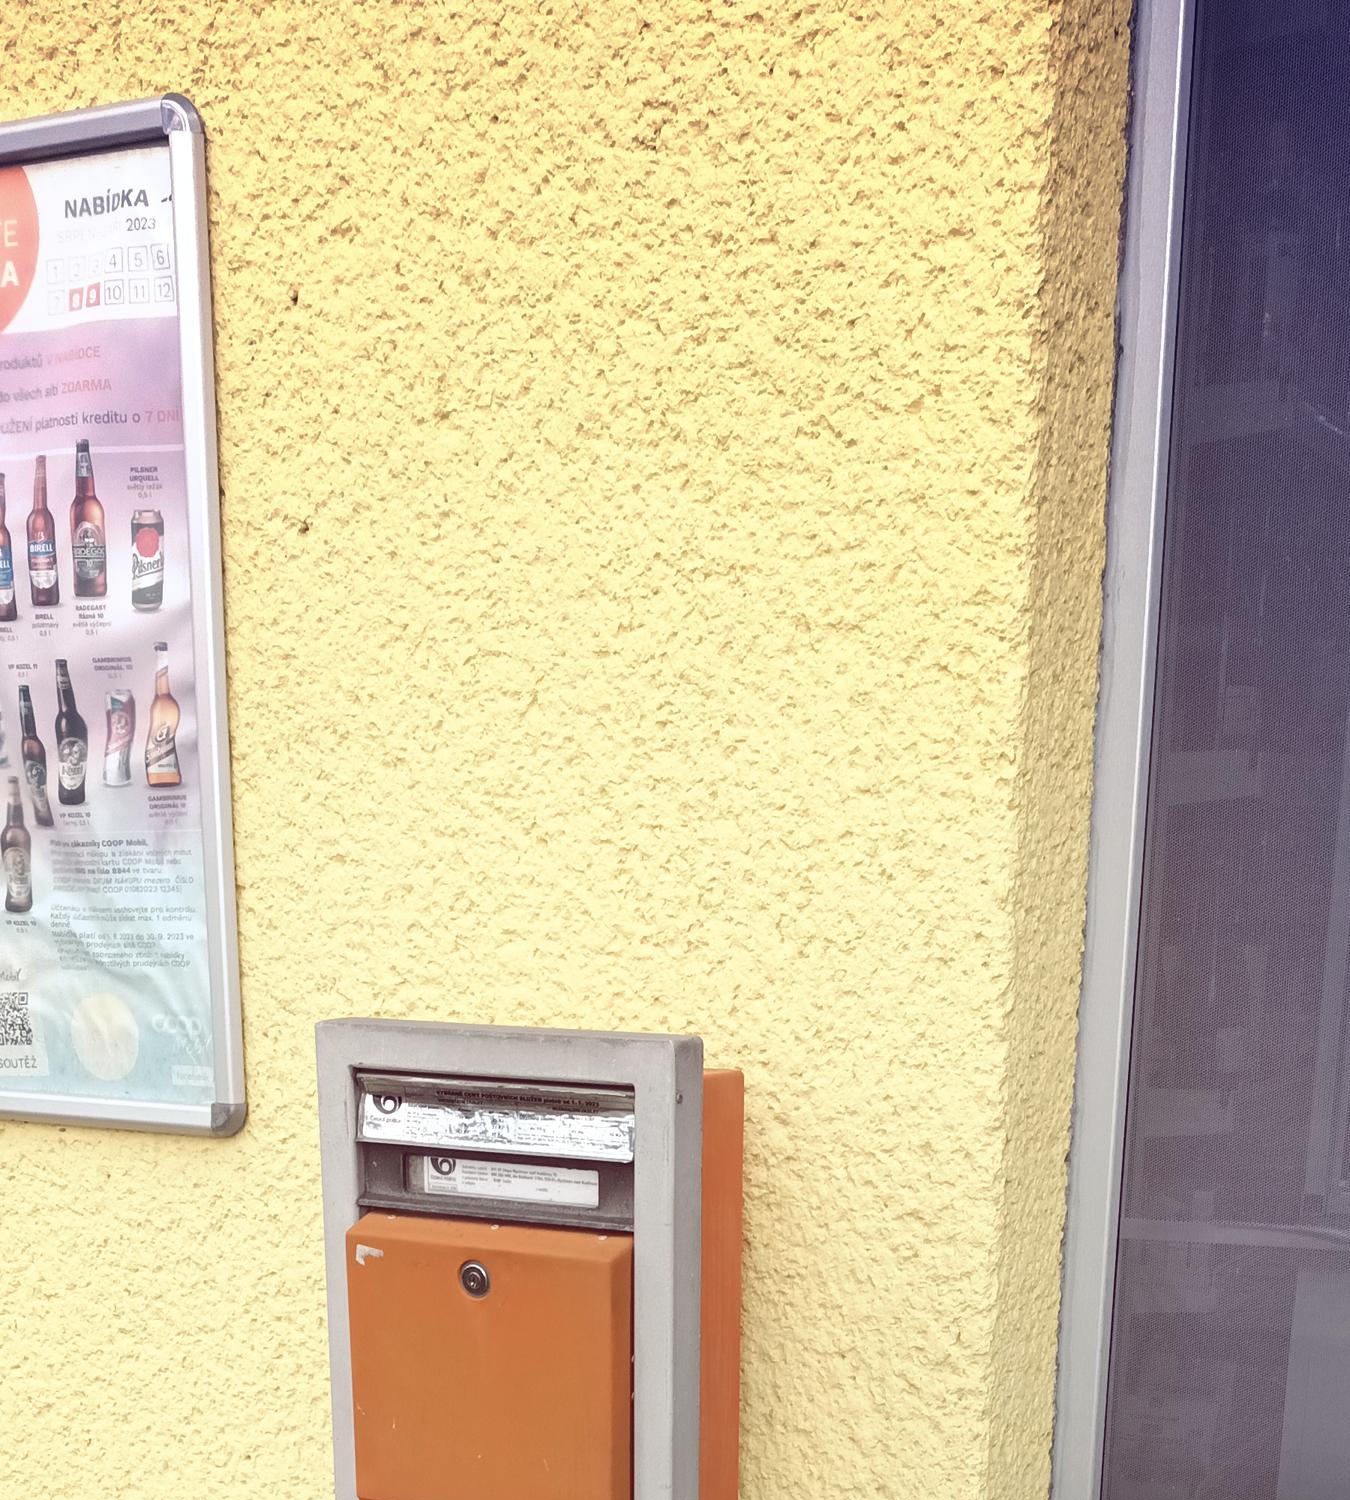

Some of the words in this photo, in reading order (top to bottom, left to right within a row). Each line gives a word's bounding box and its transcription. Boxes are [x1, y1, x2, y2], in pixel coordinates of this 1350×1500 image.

[126, 217, 156, 231] 2023
[108, 254, 117, 269] 4
[134, 252, 143, 267] 5
[156, 250, 165, 265] 6
[89, 287, 98, 303] 9
[106, 285, 122, 300] 10
[133, 285, 145, 299] 11
[158, 283, 171, 298] 12
[82, 411, 128, 425] kreditu
[132, 413, 141, 424] o
[101, 839, 124, 847] COOP
